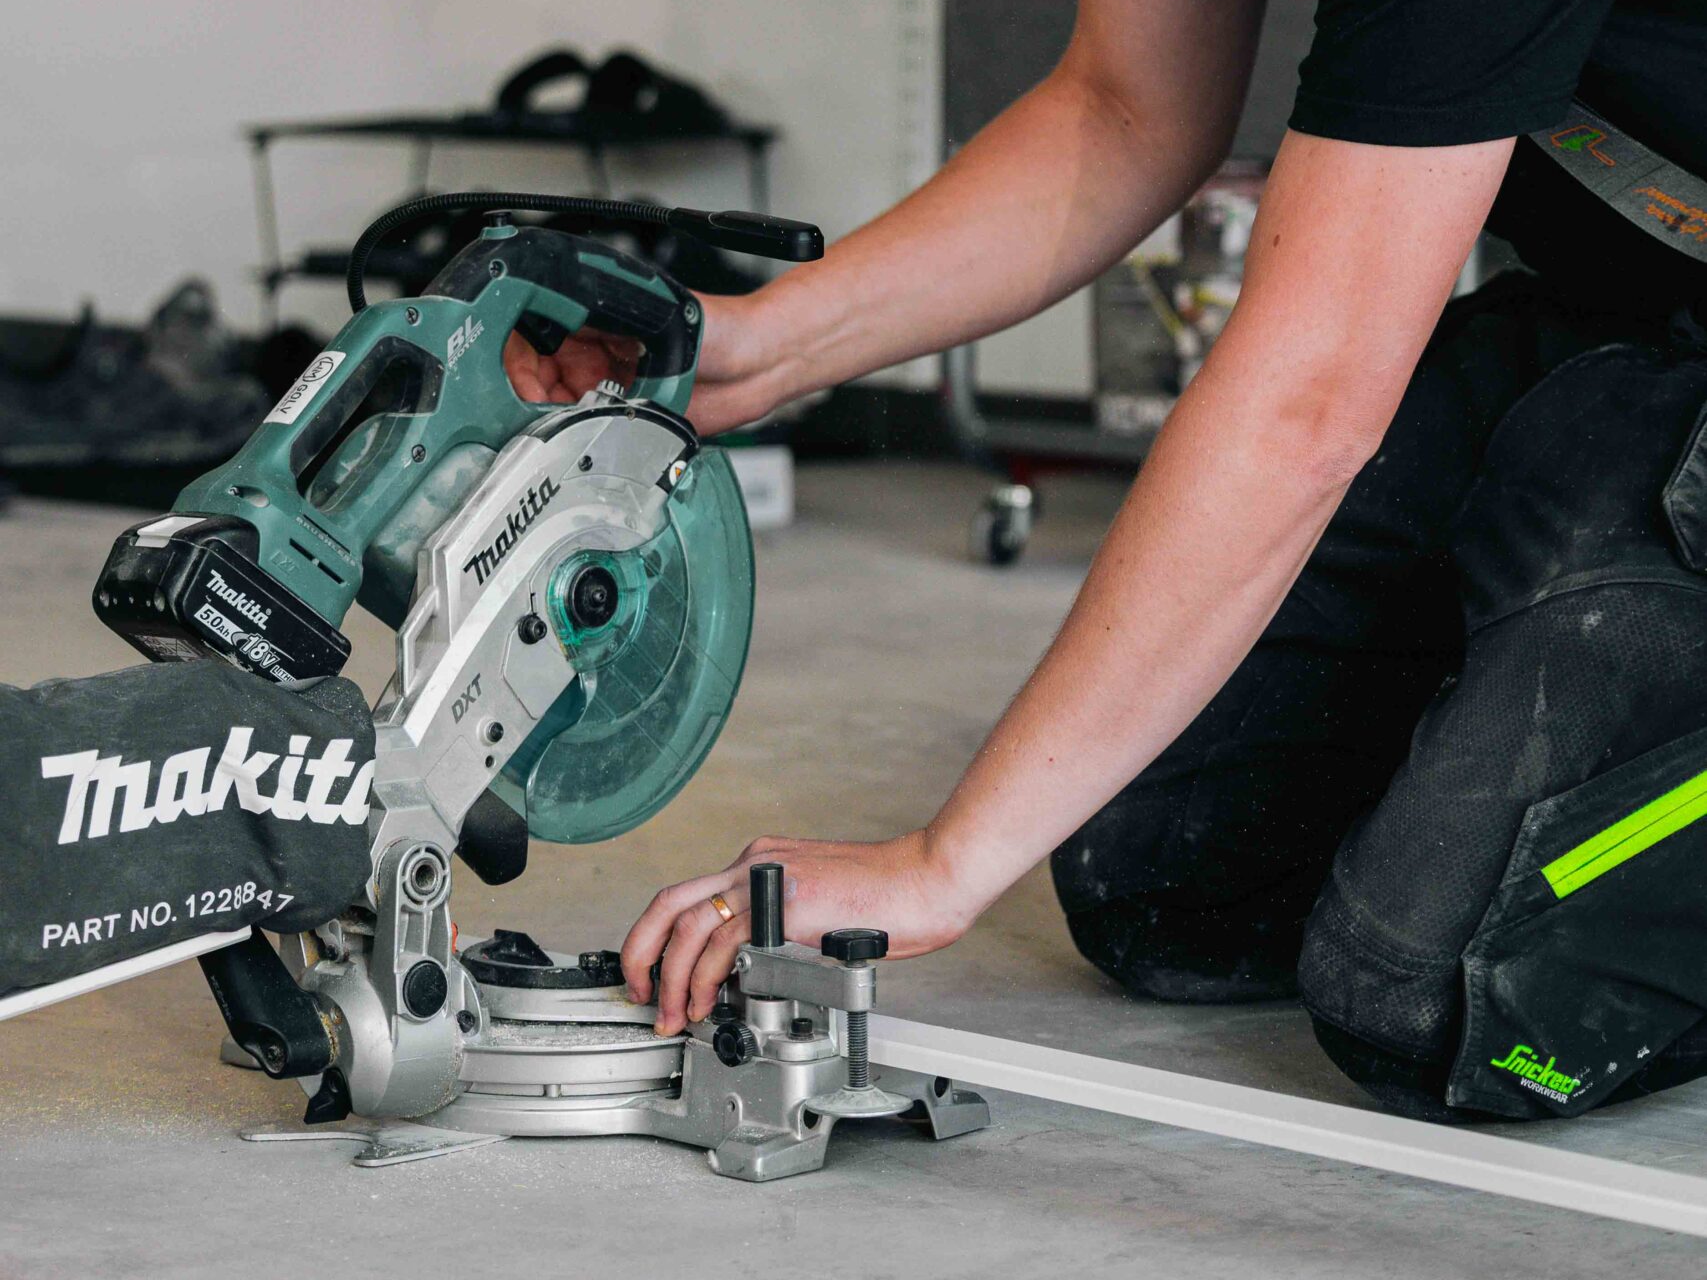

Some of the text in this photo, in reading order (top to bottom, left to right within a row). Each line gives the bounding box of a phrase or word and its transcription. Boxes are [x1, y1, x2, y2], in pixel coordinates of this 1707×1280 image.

[447, 315, 482, 363] BL
[448, 324, 485, 369] MOTOR
[279, 384, 308, 414] GOLV
[295, 516, 357, 567] BRUSHLESS
[200, 608, 230, 638] 5.0Ah
[451, 673, 483, 724] DXT
[42, 881, 294, 949] PART NO. 1228847
[1490, 1045, 1581, 1095] Snickers
[1520, 1077, 1568, 1104] WORKWEAR
